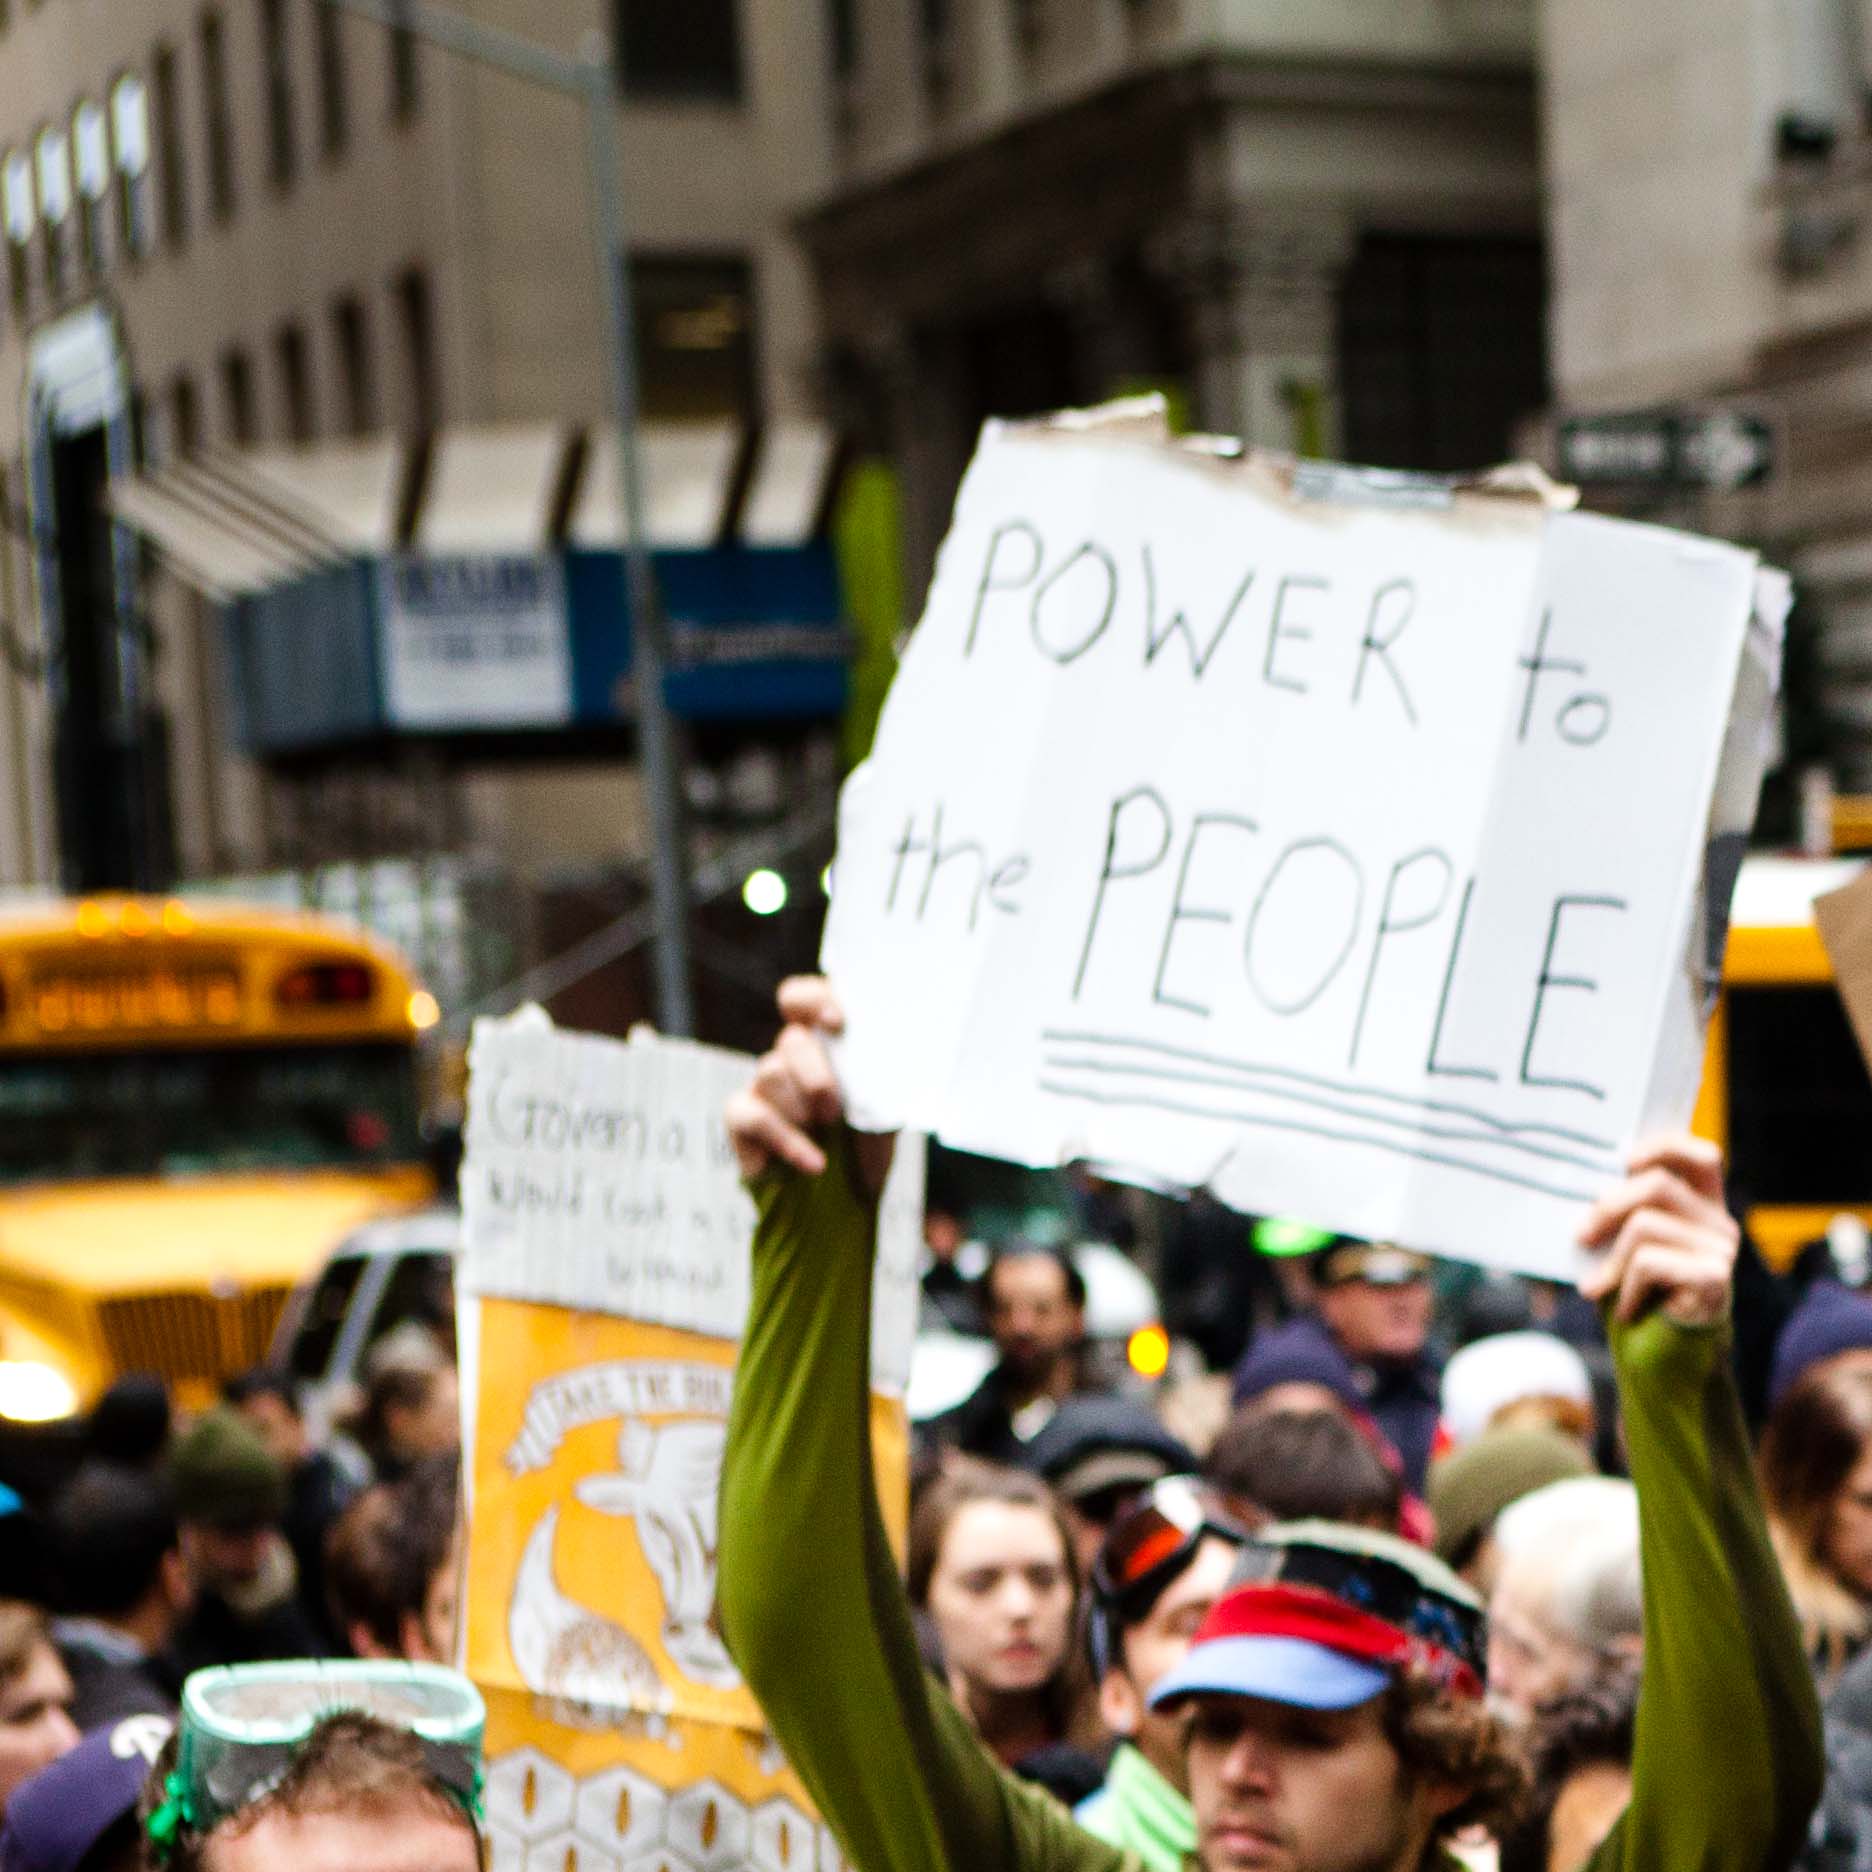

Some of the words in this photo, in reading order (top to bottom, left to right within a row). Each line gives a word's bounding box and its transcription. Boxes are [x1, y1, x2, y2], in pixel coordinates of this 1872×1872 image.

[963, 516, 1420, 728] POWER
[1517, 607, 1614, 746] to
[883, 804, 1034, 934] the
[1072, 785, 1628, 1100] PEOPLE
